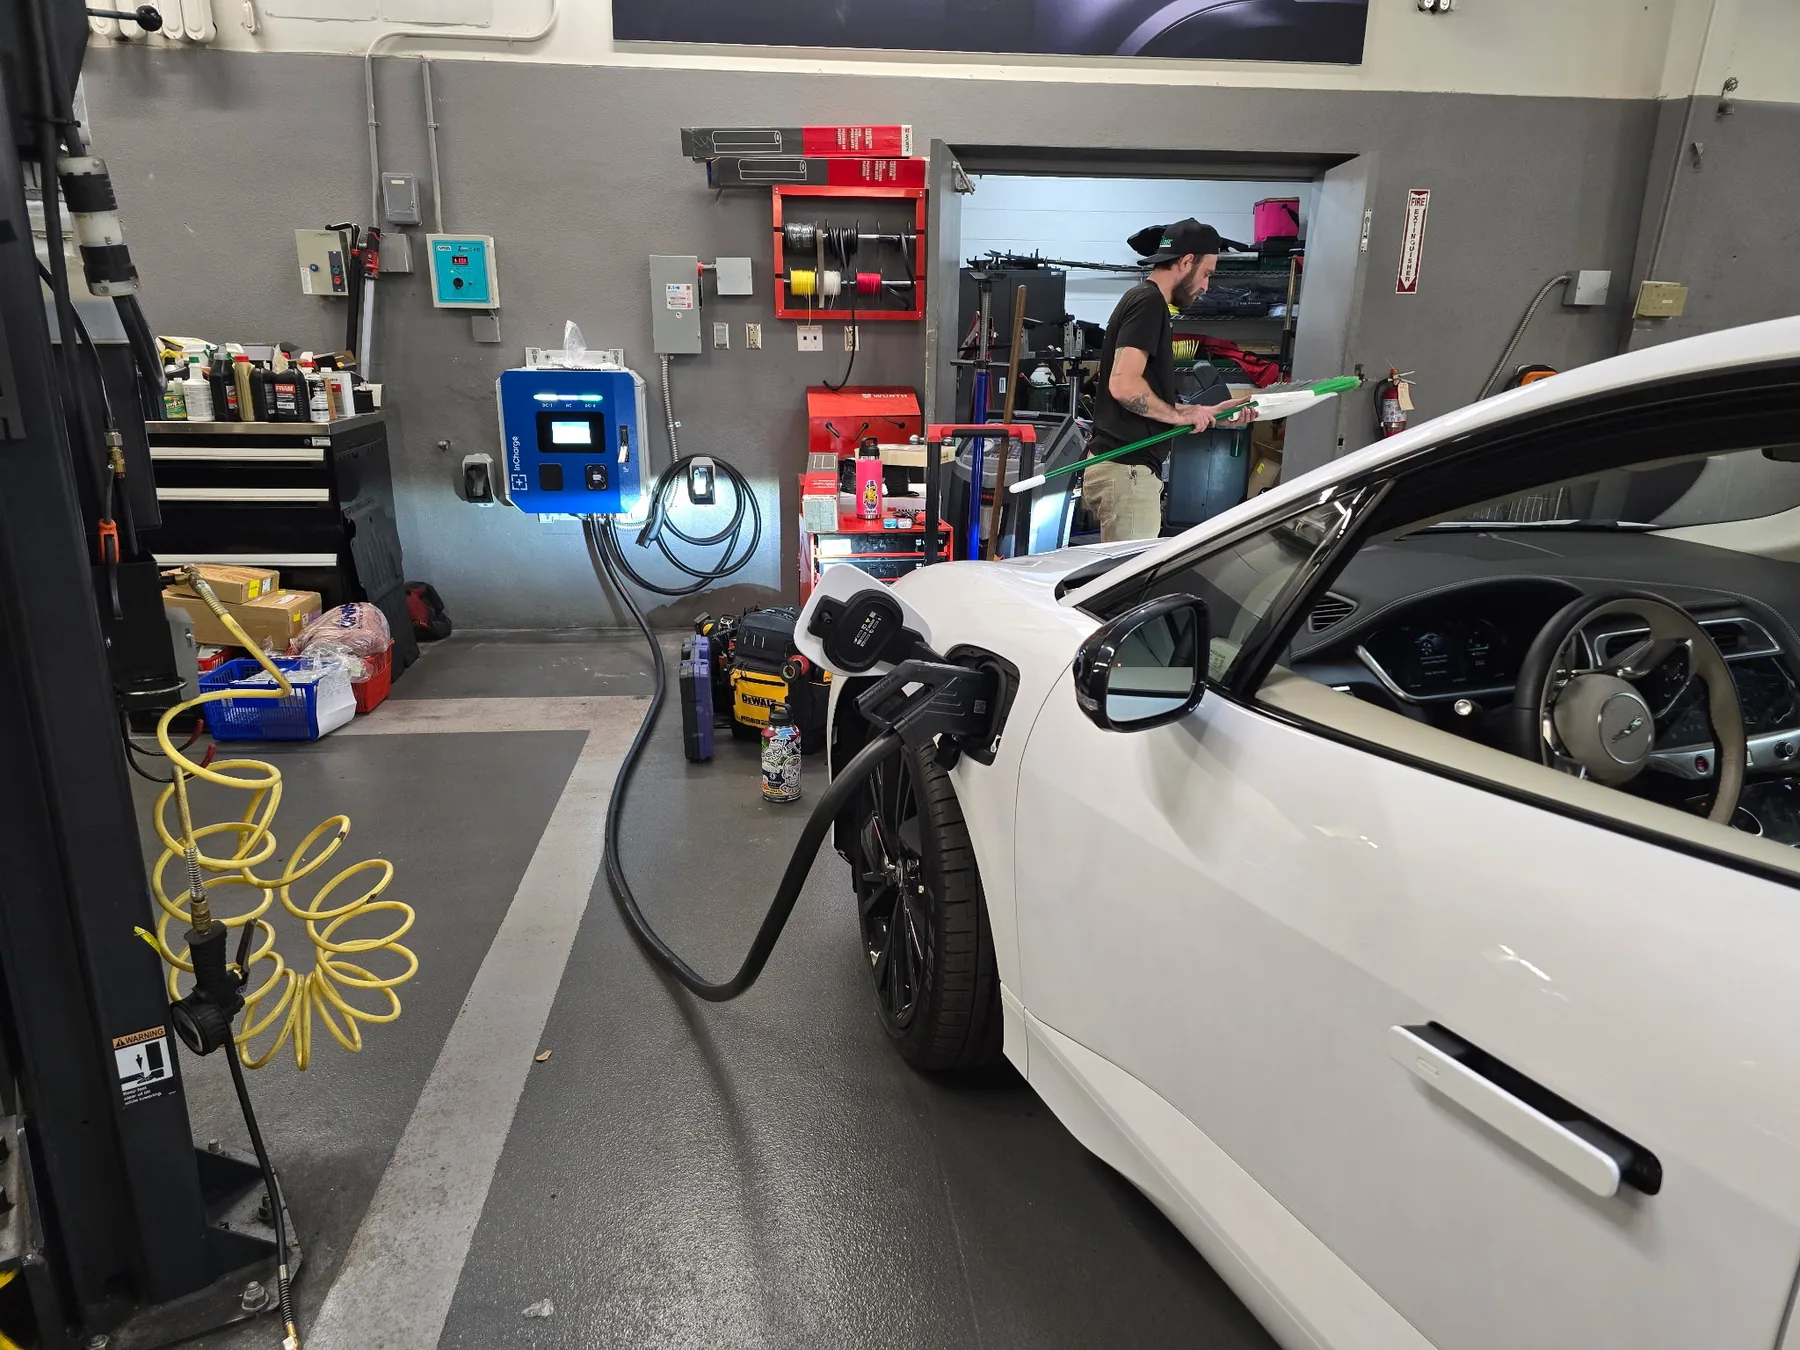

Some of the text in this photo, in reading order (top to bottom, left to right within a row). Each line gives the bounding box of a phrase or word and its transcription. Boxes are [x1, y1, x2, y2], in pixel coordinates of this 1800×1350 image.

[1411, 197, 1425, 207] FIRE
[1405, 208, 1419, 282] EXTINGUISHER
[275, 384, 295, 392] FRAM
[512, 436, 521, 471] InCharge
[125, 1028, 164, 1043] WARNING
